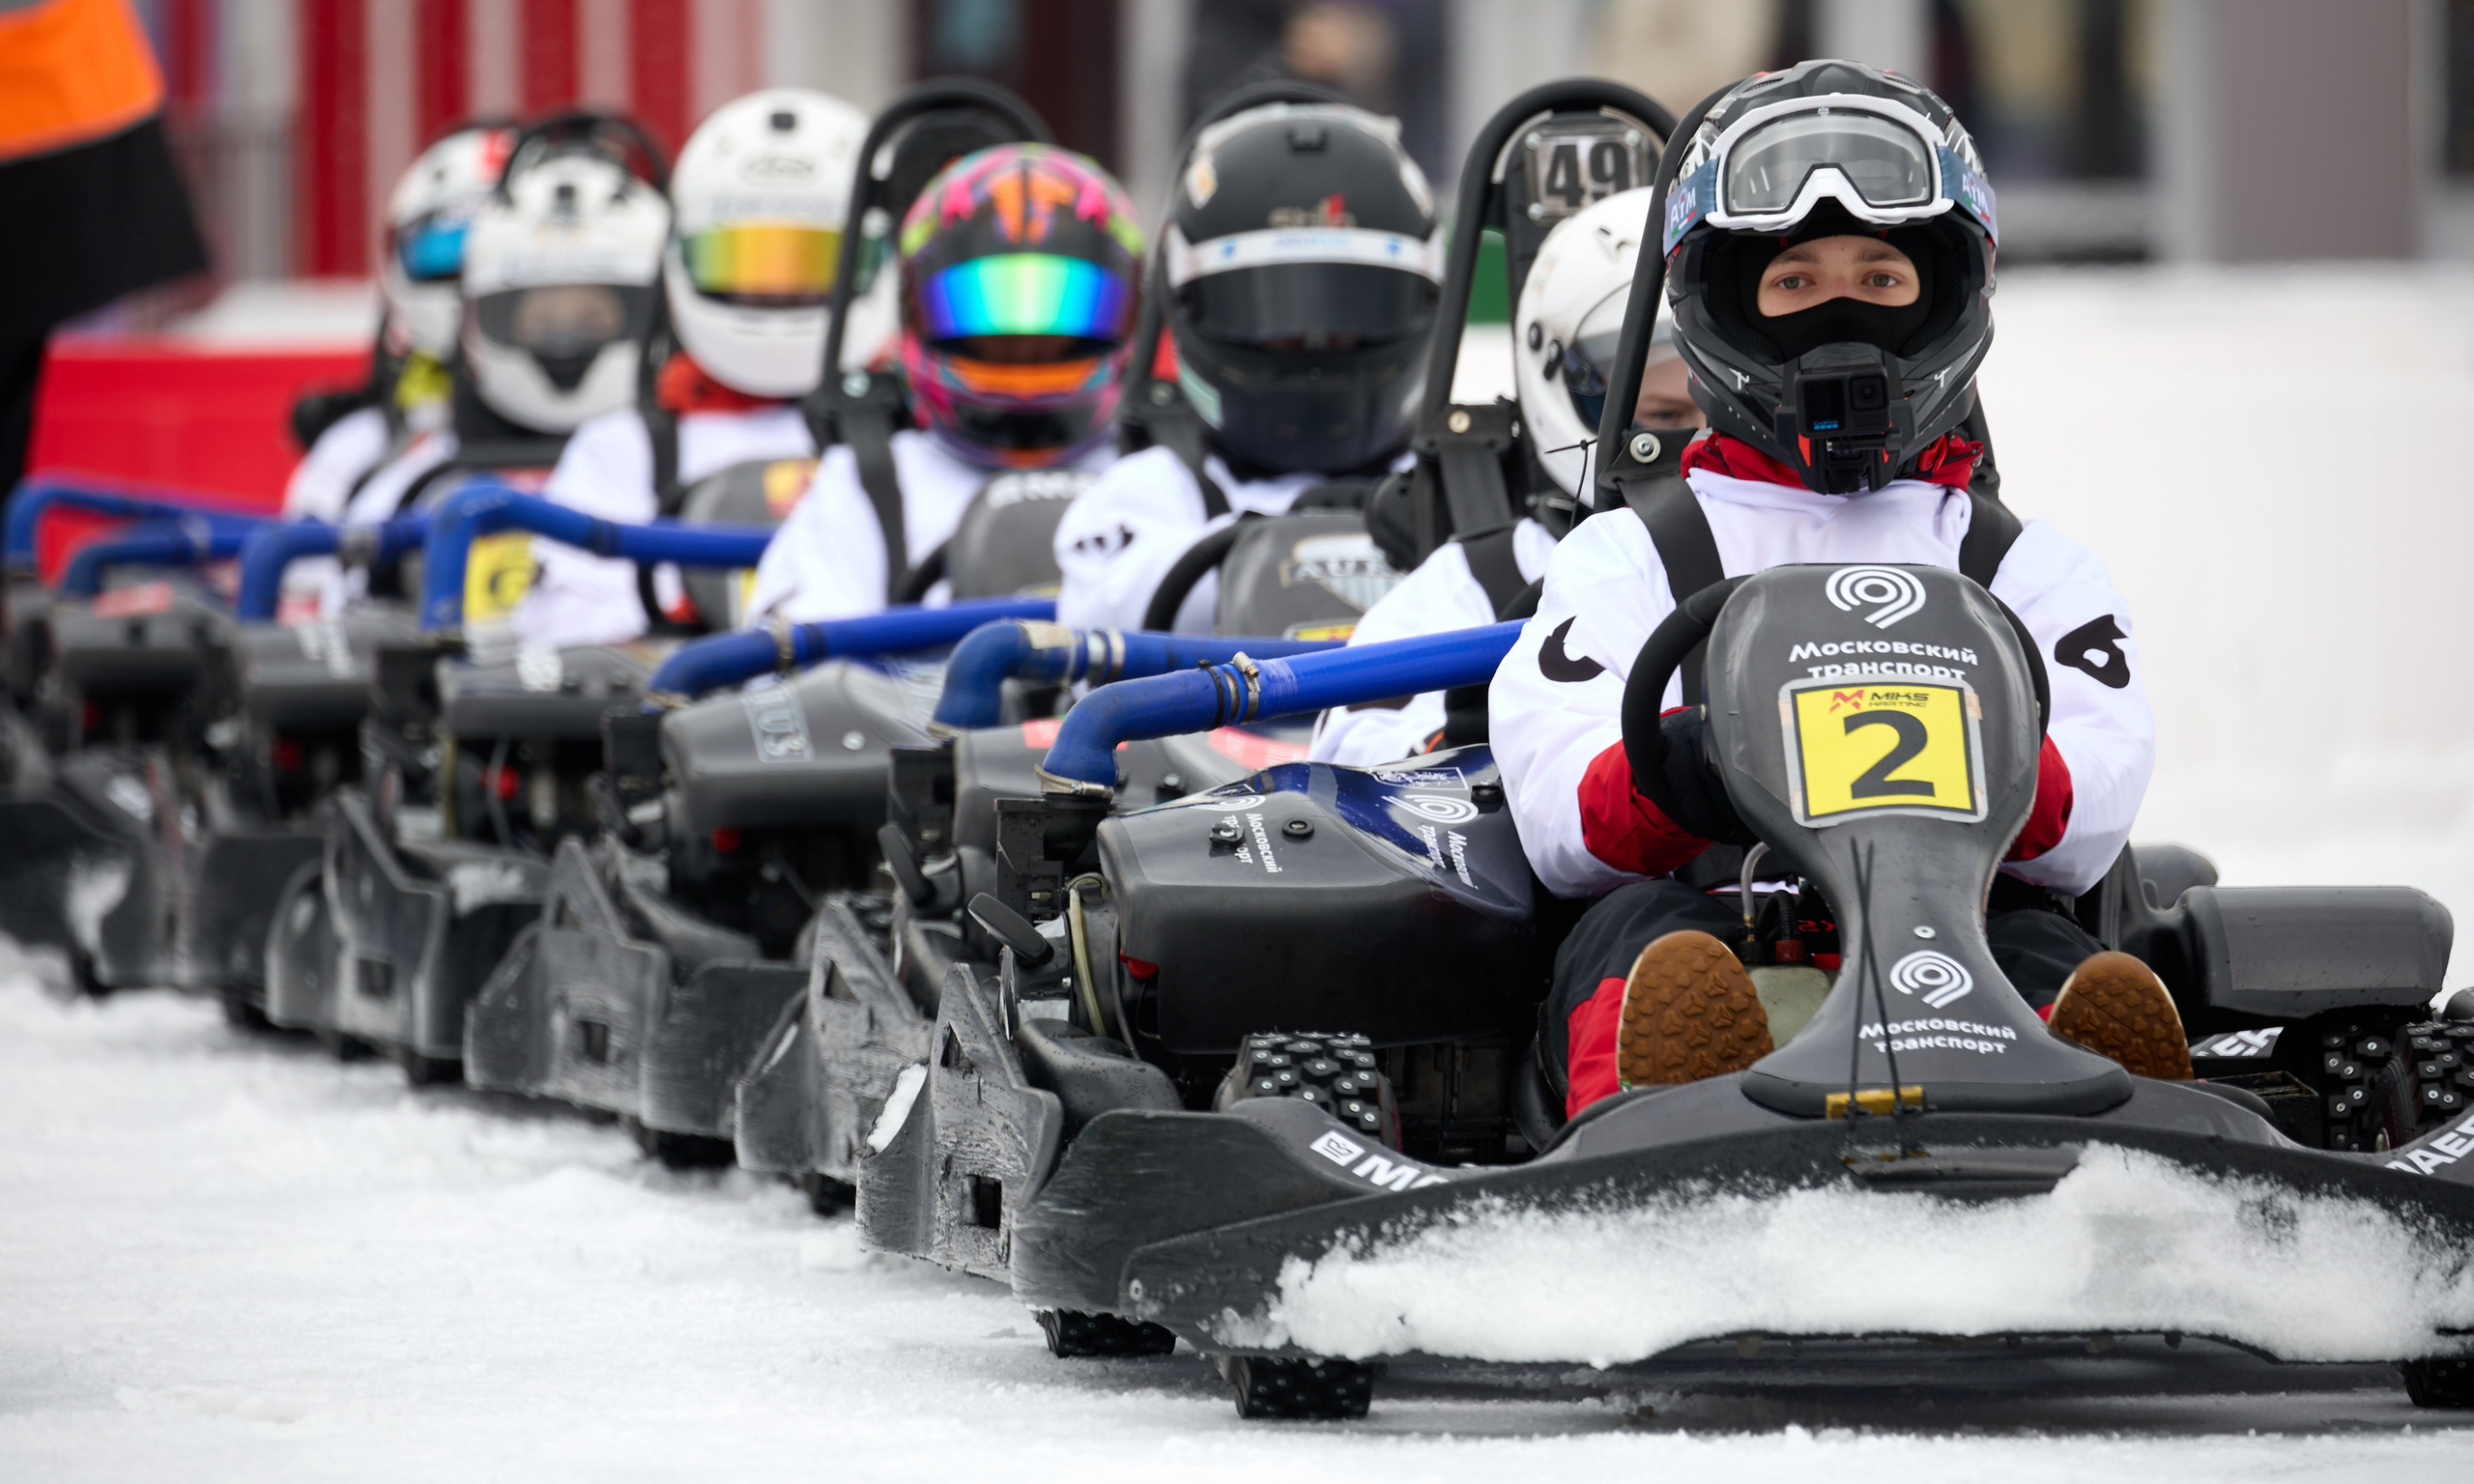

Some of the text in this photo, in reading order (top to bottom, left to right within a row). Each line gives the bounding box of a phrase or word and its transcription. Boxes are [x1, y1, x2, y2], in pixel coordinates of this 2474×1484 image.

[1547, 142, 1630, 208] 49
[1789, 640, 1979, 667] Московский
[1807, 661, 1967, 680] транспорт
[1871, 692, 1930, 701] MIKS
[1843, 709, 1937, 800] 2
[1246, 813, 1282, 873] Московский
[1858, 1017, 2018, 1042] Московский
[1873, 1034, 2007, 1055] транспорт
